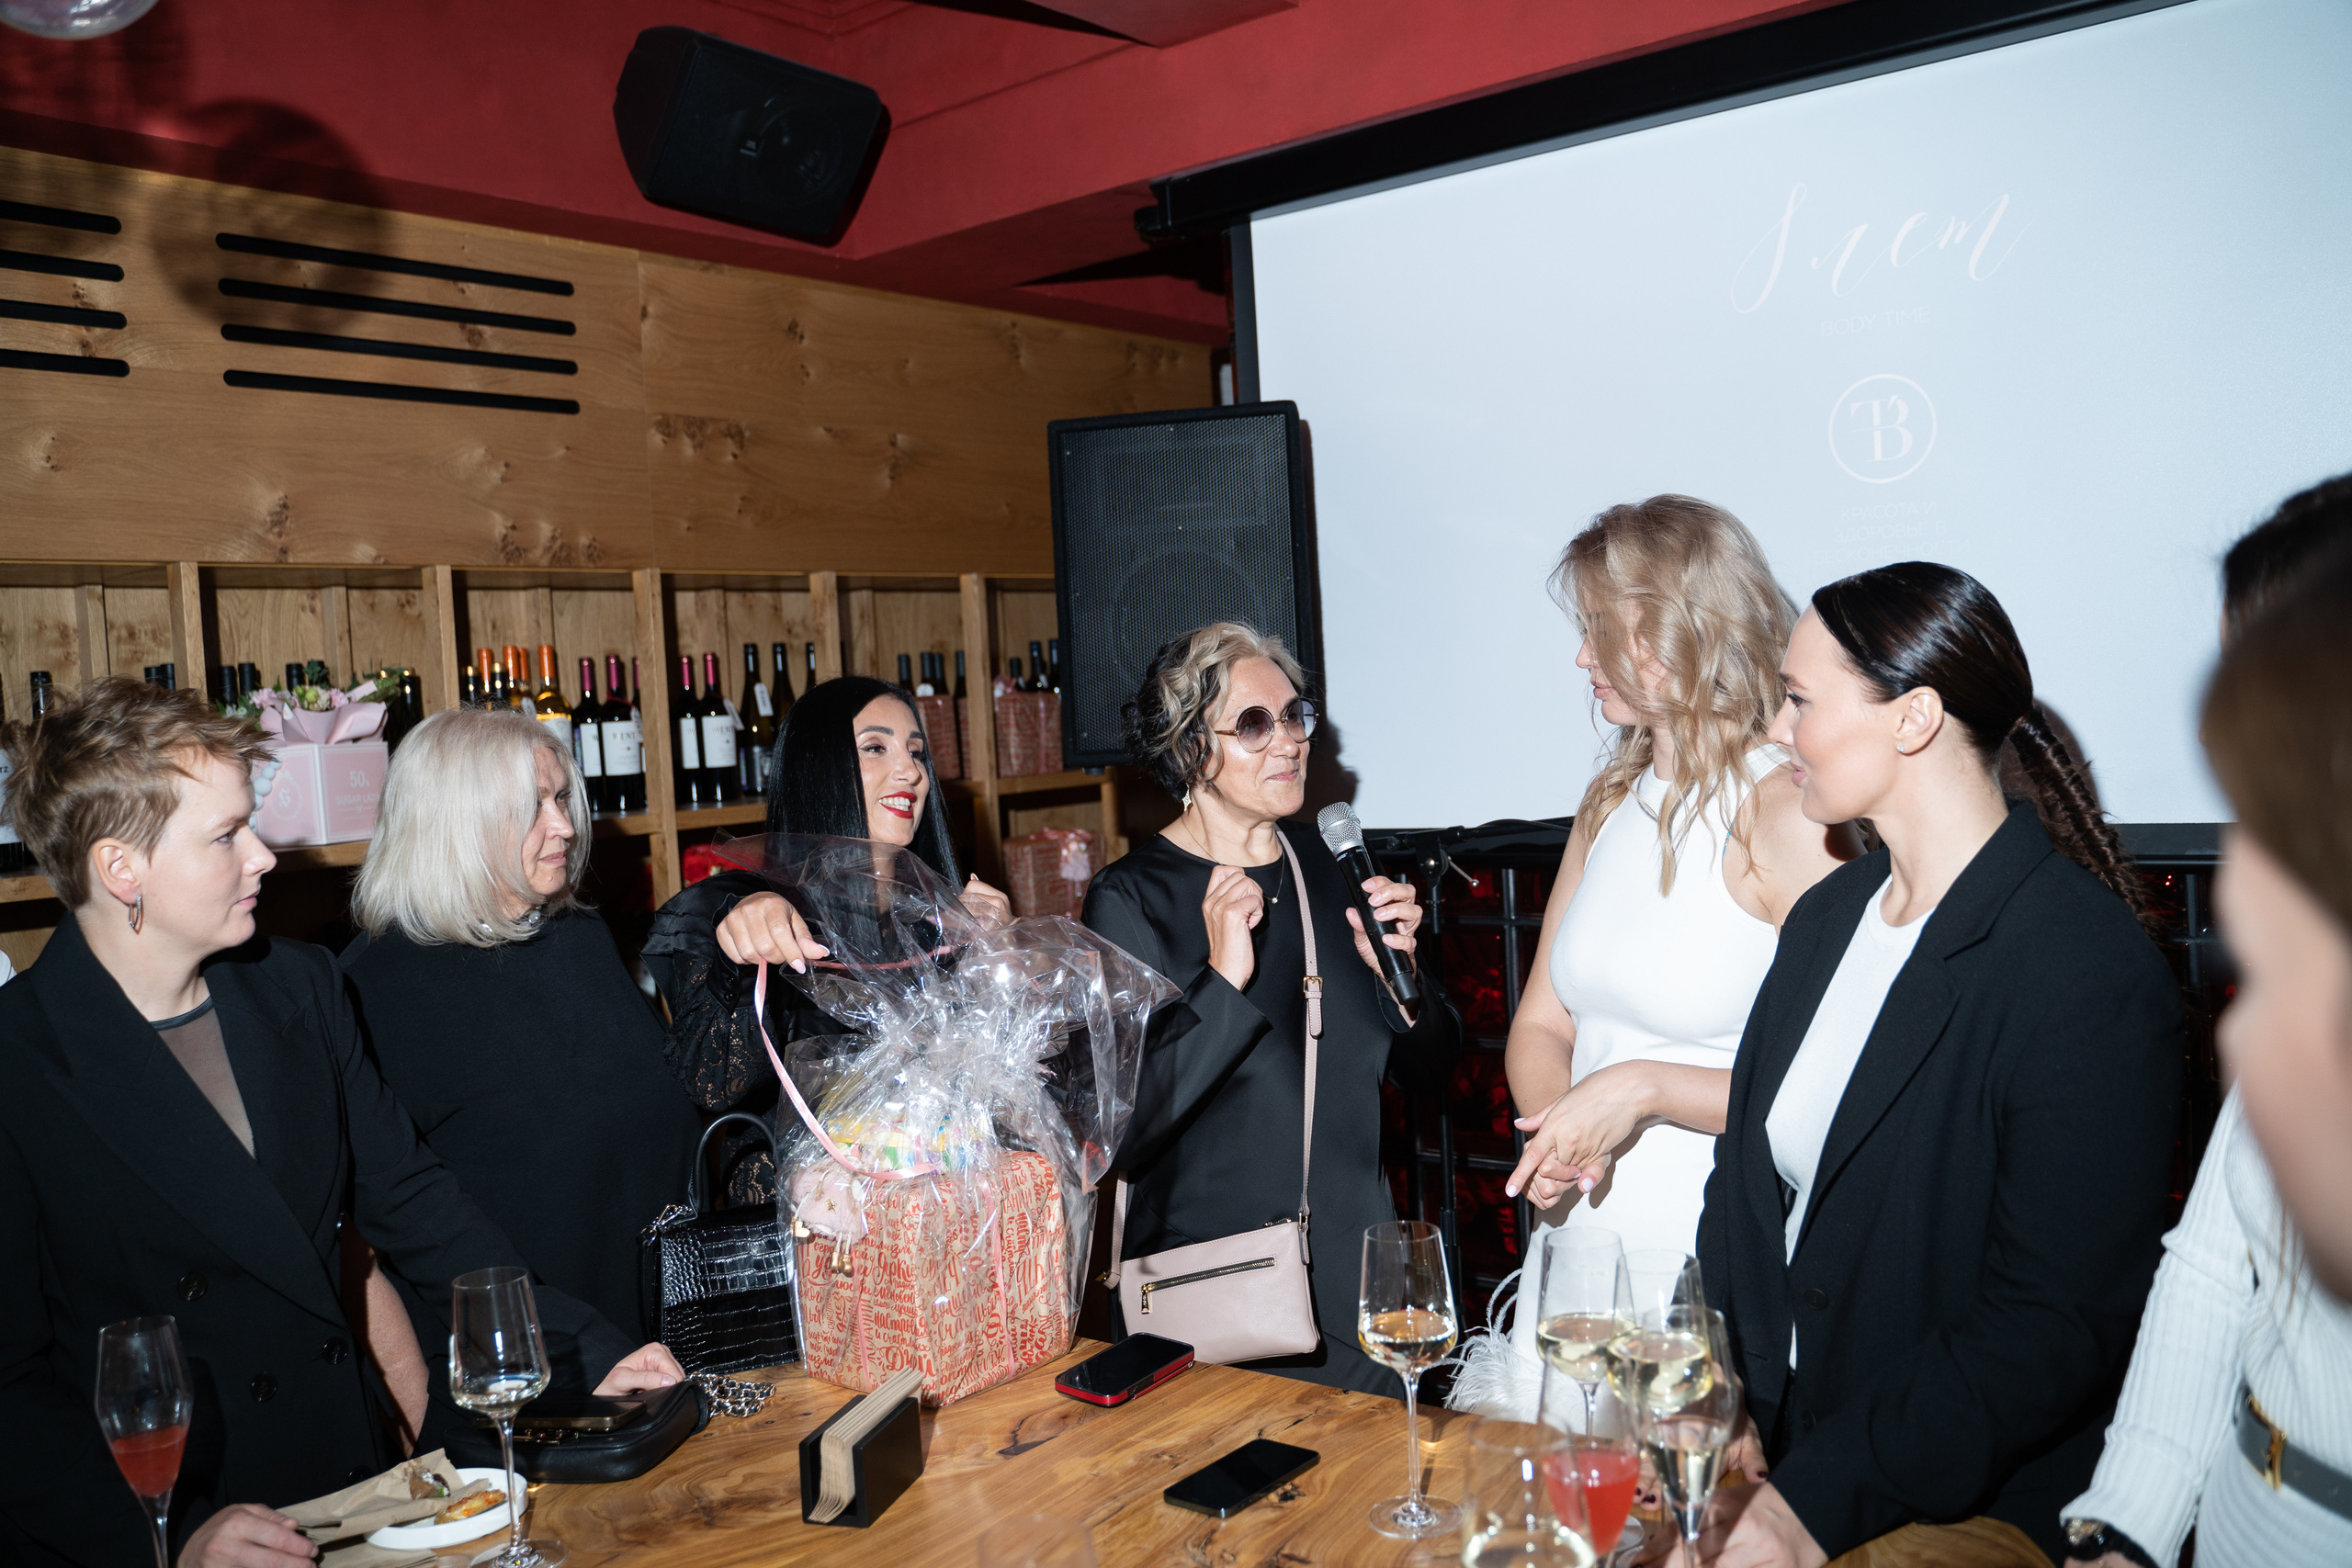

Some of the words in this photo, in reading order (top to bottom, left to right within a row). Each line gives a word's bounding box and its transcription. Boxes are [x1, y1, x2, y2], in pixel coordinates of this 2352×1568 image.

[1821, 312, 1878, 337] BODY
[1883, 306, 1931, 330] TIME
[1840, 502, 1918, 522] КРАСОТА
[1923, 501, 1938, 515] И
[1833, 521, 1929, 544] ЗДОРОВЬЕ
[1935, 519, 1947, 536] В
[1814, 539, 1971, 565] БЕСКОНЕЧНОСТИ
